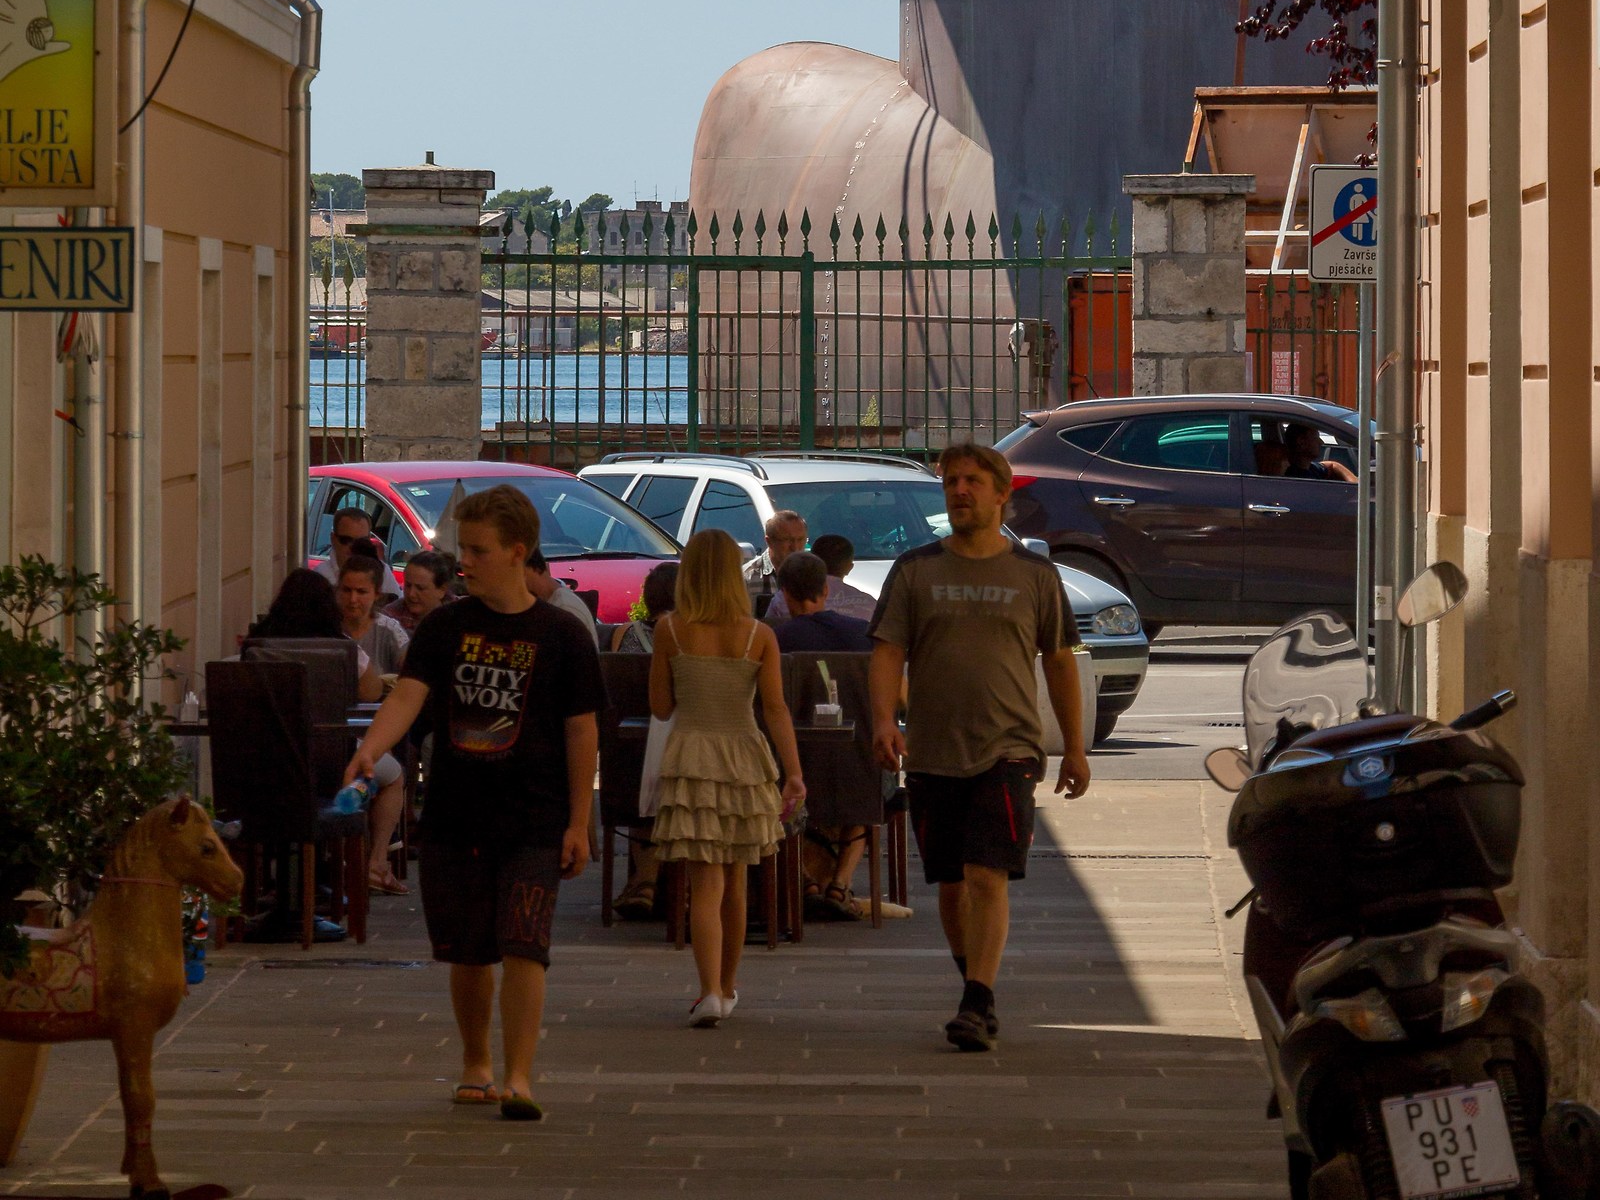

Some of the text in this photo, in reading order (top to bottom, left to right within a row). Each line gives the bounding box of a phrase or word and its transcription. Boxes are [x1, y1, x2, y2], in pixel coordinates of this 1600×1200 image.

[0, 109, 68, 145] LJE
[1344, 248, 1376, 261] Završe
[0, 238, 125, 304] ENIRI
[1329, 263, 1373, 277] pješačke
[931, 584, 1020, 603] FENDT
[455, 663, 528, 690] CITY
[454, 685, 523, 712] WOK
[1405, 1097, 1453, 1131] PU
[1418, 1124, 1477, 1159] 931
[1432, 1155, 1481, 1188] PE
